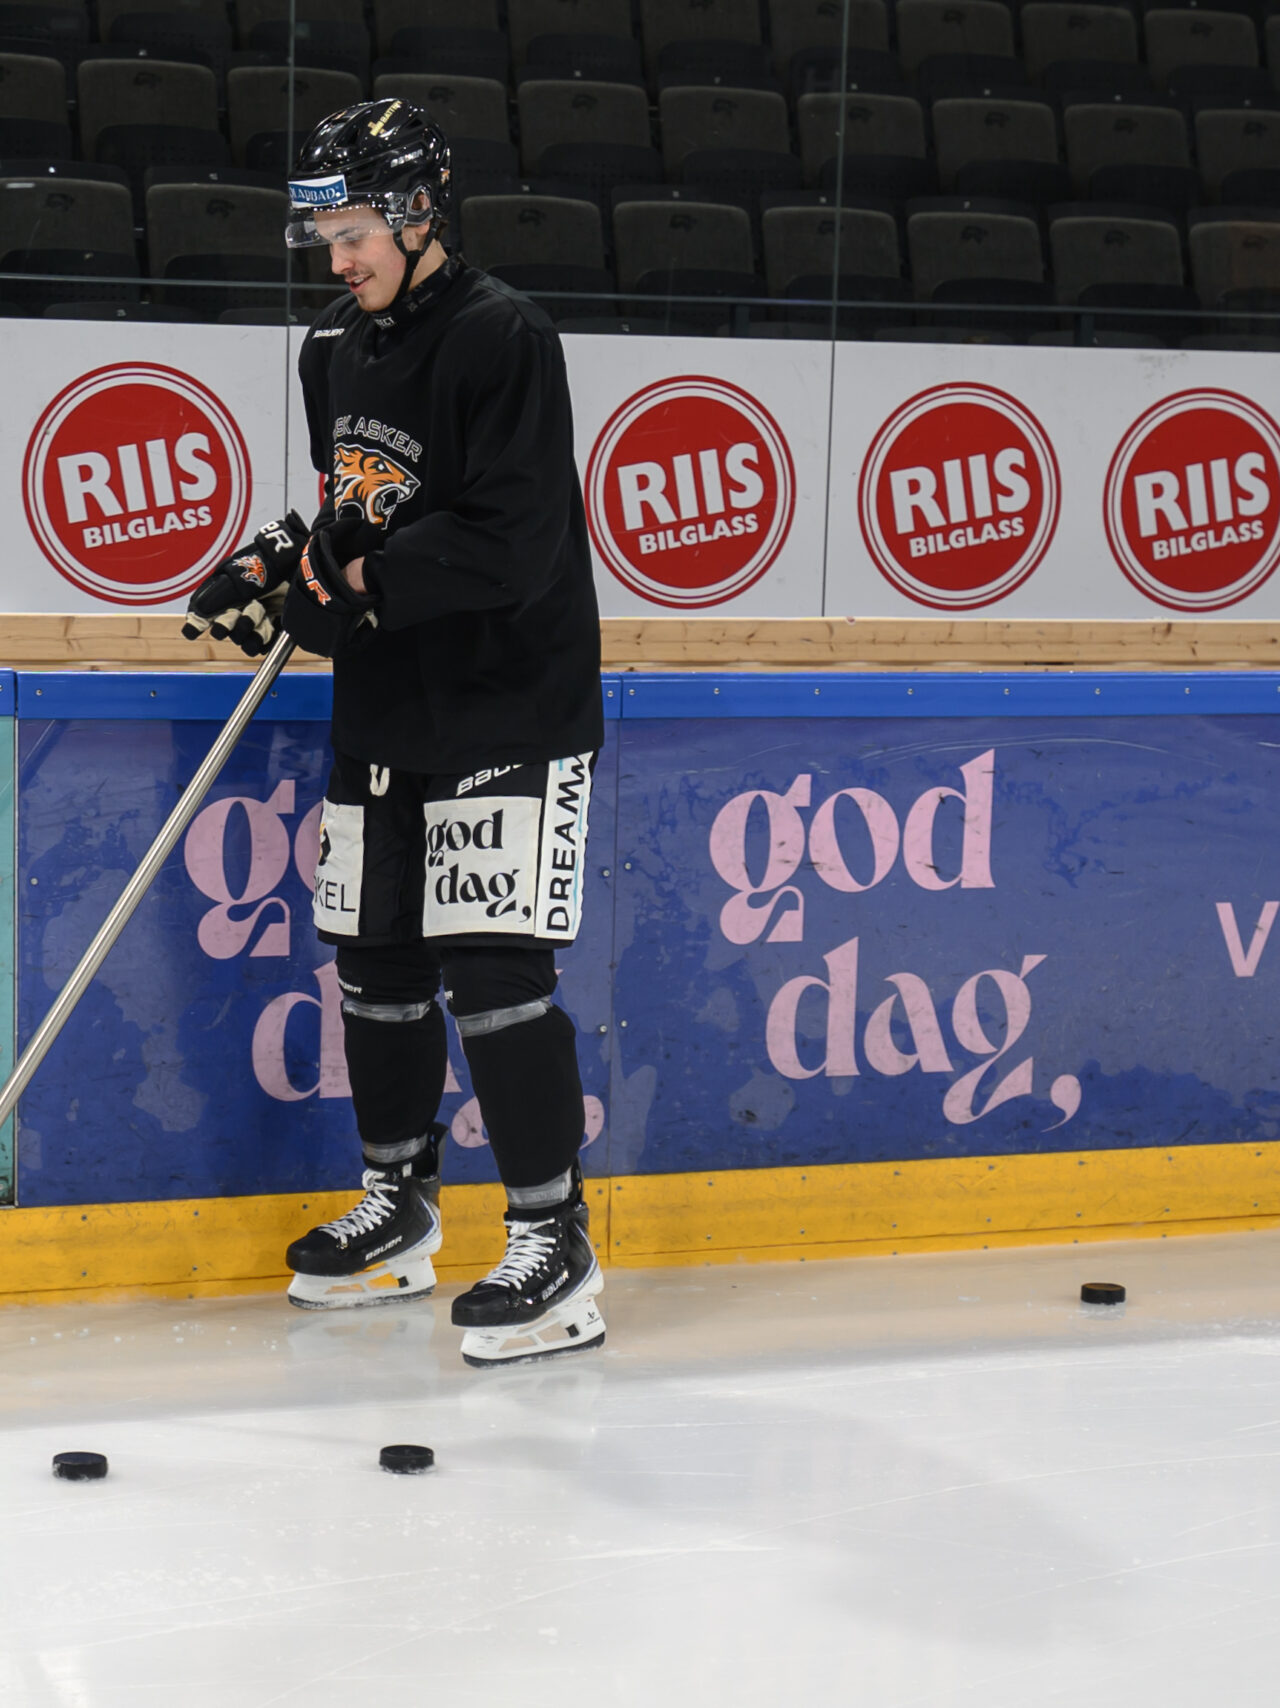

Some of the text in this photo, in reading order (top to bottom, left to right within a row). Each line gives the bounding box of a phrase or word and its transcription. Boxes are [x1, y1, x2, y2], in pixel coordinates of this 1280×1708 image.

[353, 416, 423, 463] ASKER
[58, 433, 217, 524] RIIS
[618, 443, 764, 531] RIIS
[890, 448, 1031, 535] RIIS
[1134, 453, 1270, 538] RIIS
[83, 506, 213, 549] BILGLASS
[639, 514, 759, 555] BILGLASS
[910, 517, 1025, 558] BILGLASS
[1153, 520, 1264, 561] BILGLASS
[427, 808, 504, 868] god
[710, 748, 995, 945] god
[435, 862, 532, 923] dag,
[766, 936, 1082, 1133] dag,
[365, 1235, 403, 1262] BAUER
